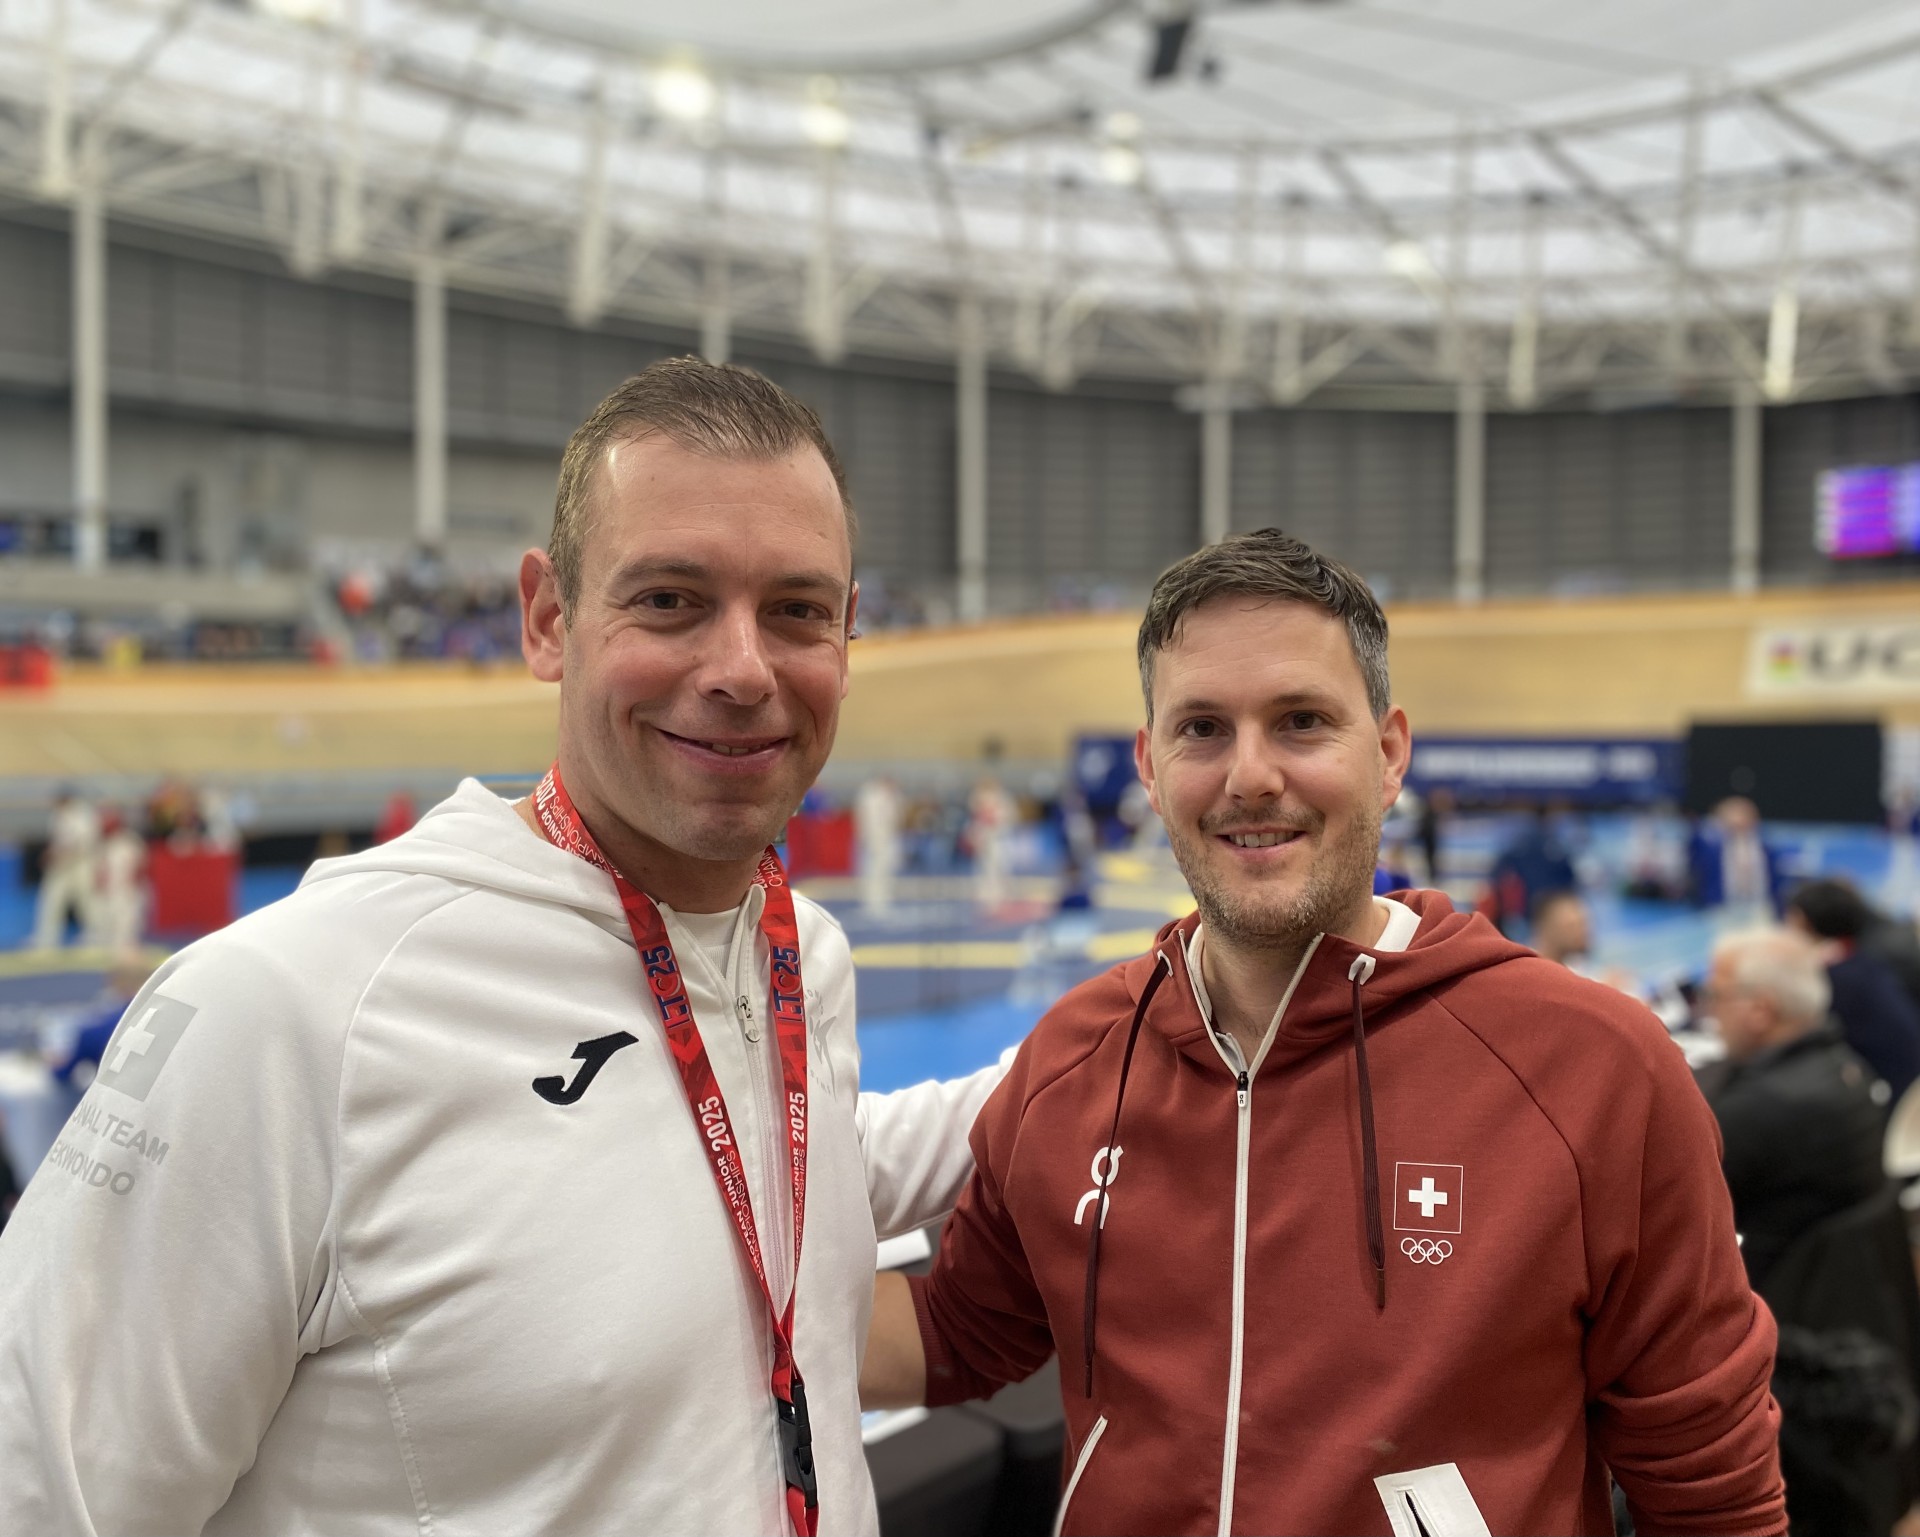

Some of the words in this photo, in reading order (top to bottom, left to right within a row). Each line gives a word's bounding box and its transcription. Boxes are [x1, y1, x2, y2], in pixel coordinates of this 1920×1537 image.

[541, 808, 566, 847] JUNIOR
[101, 1113, 170, 1166] TEAM
[697, 1096, 732, 1152] 2025
[789, 1092, 805, 1144] 2025
[717, 1155, 740, 1208] JUNIOR
[792, 1147, 800, 1200] JUNIOR
